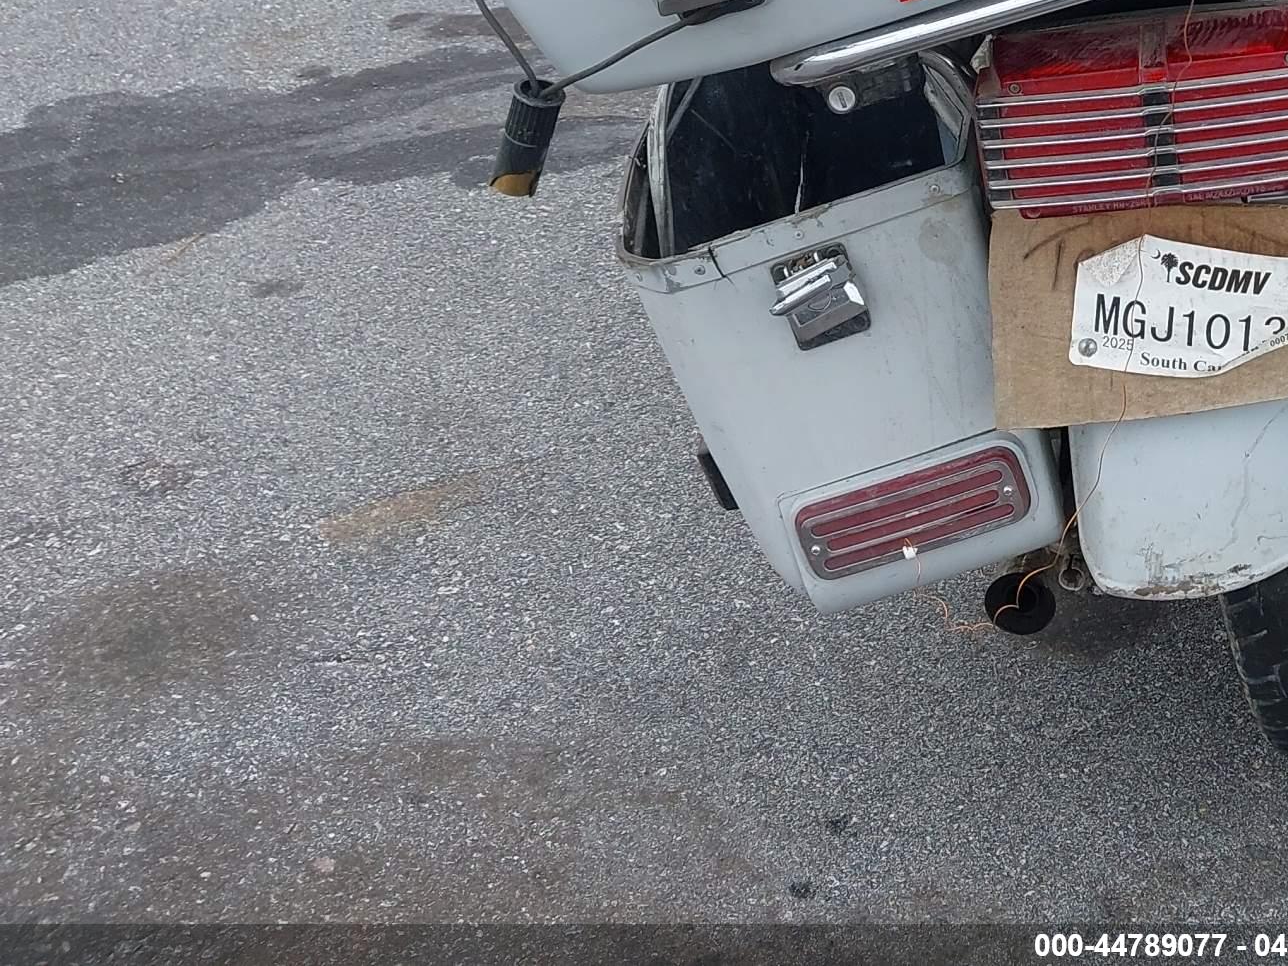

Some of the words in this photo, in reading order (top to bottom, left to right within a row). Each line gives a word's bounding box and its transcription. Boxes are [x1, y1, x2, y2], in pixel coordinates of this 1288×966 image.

[1175, 261, 1272, 295] SCDMV
[1102, 336, 1134, 351] 2025
[1140, 352, 1187, 371] South
